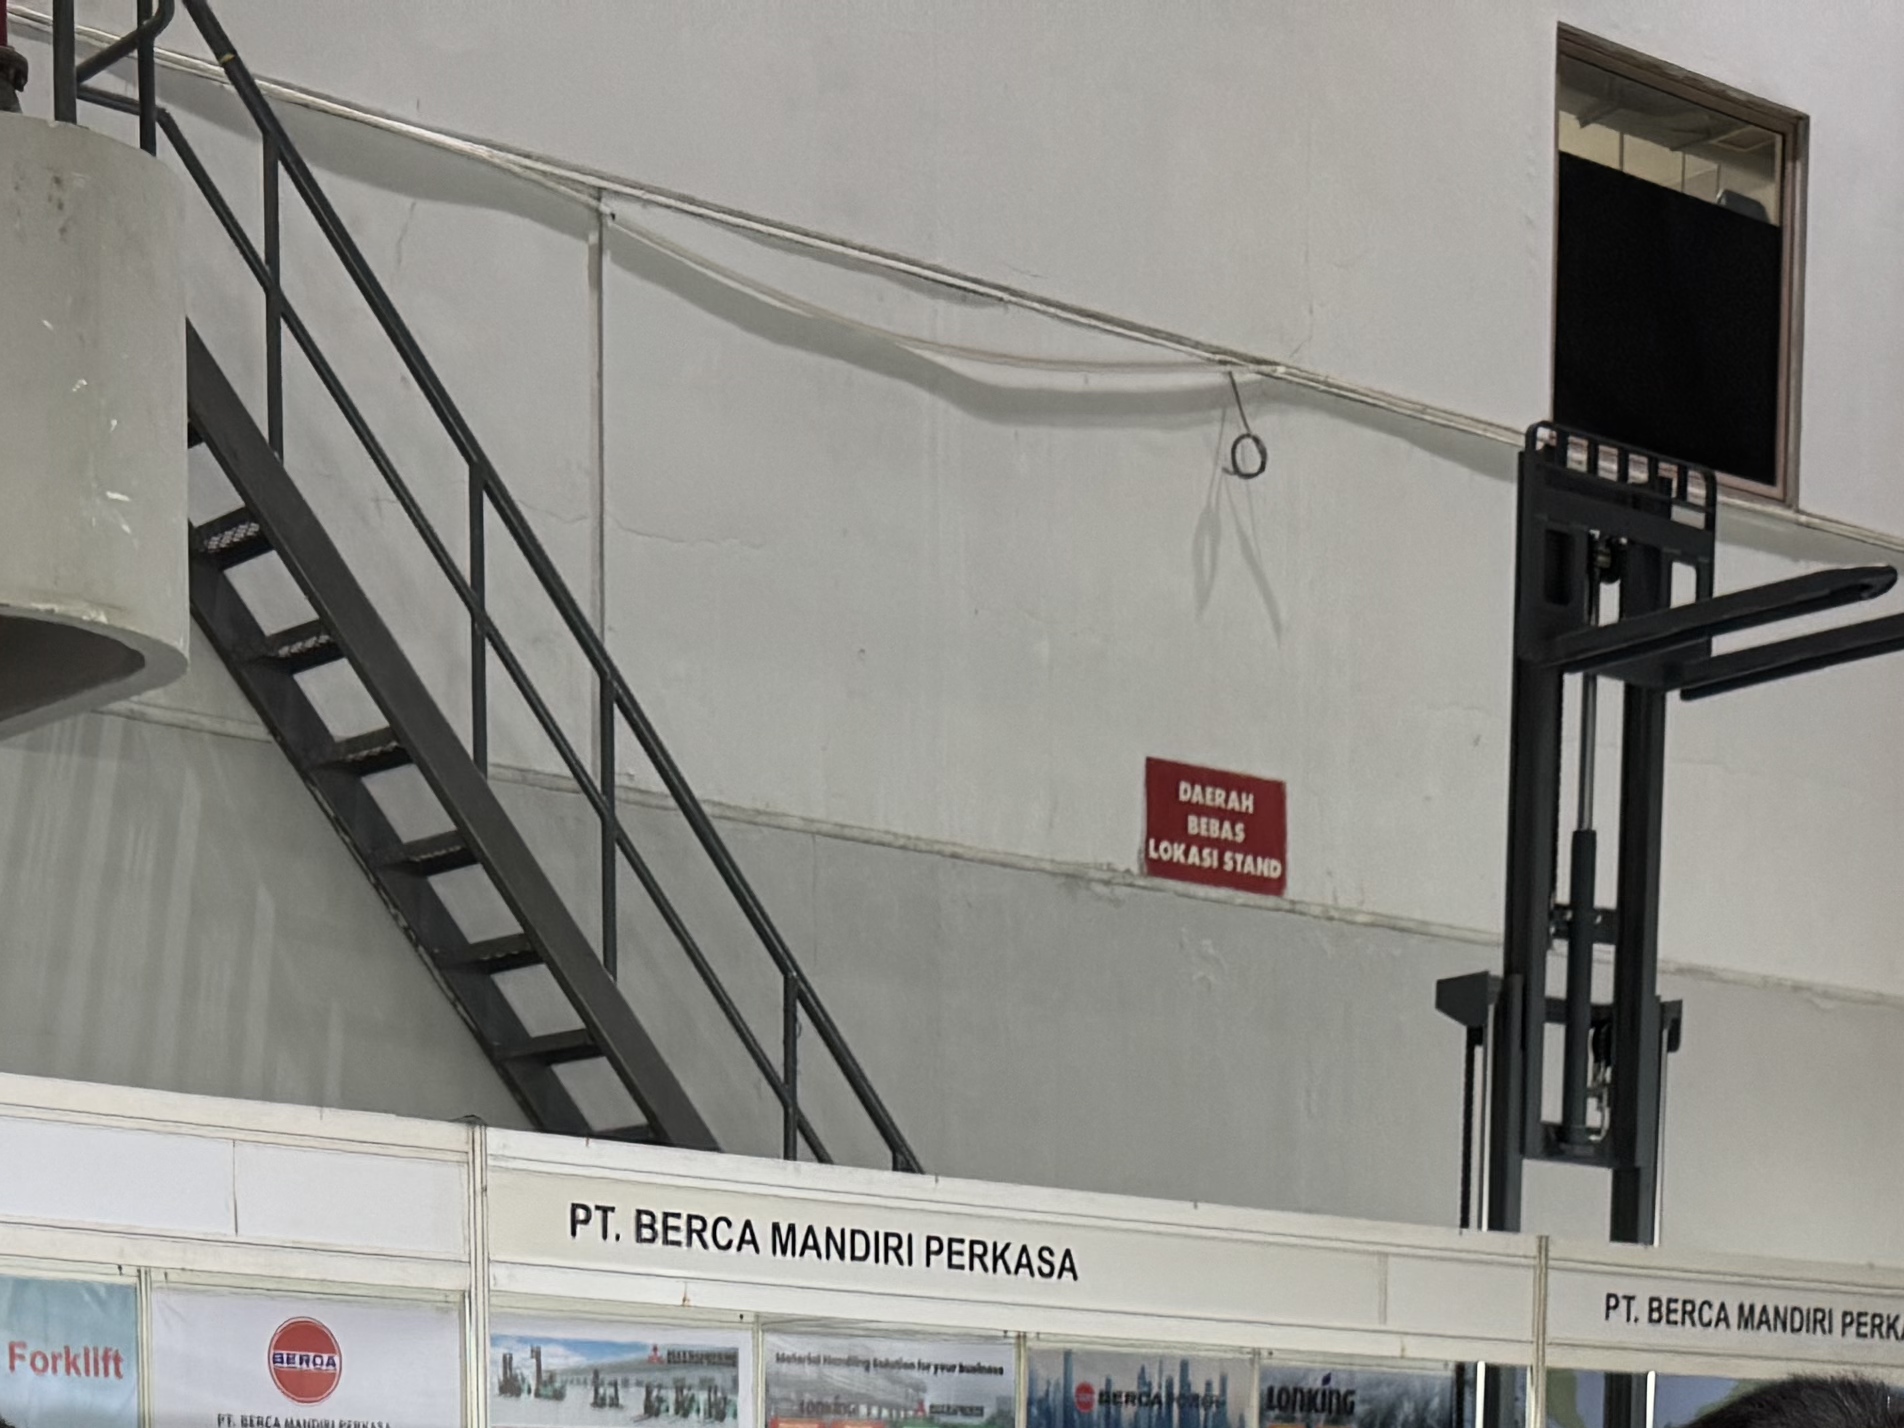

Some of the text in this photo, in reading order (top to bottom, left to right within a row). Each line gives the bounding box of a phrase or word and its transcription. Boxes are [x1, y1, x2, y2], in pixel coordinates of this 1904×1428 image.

[1179, 781, 1254, 814] DAERAH
[1188, 815, 1245, 843] BEBAS
[1149, 838, 1282, 879] LOKASI STAND
[569, 1203, 1079, 1283] PT. BERCA MANDIRI PERKASA
[1604, 1292, 1639, 1323] PT.
[1647, 1296, 1731, 1330] BERCA
[1737, 1302, 1834, 1335] MANDIRI
[8, 1341, 124, 1380] Forklift
